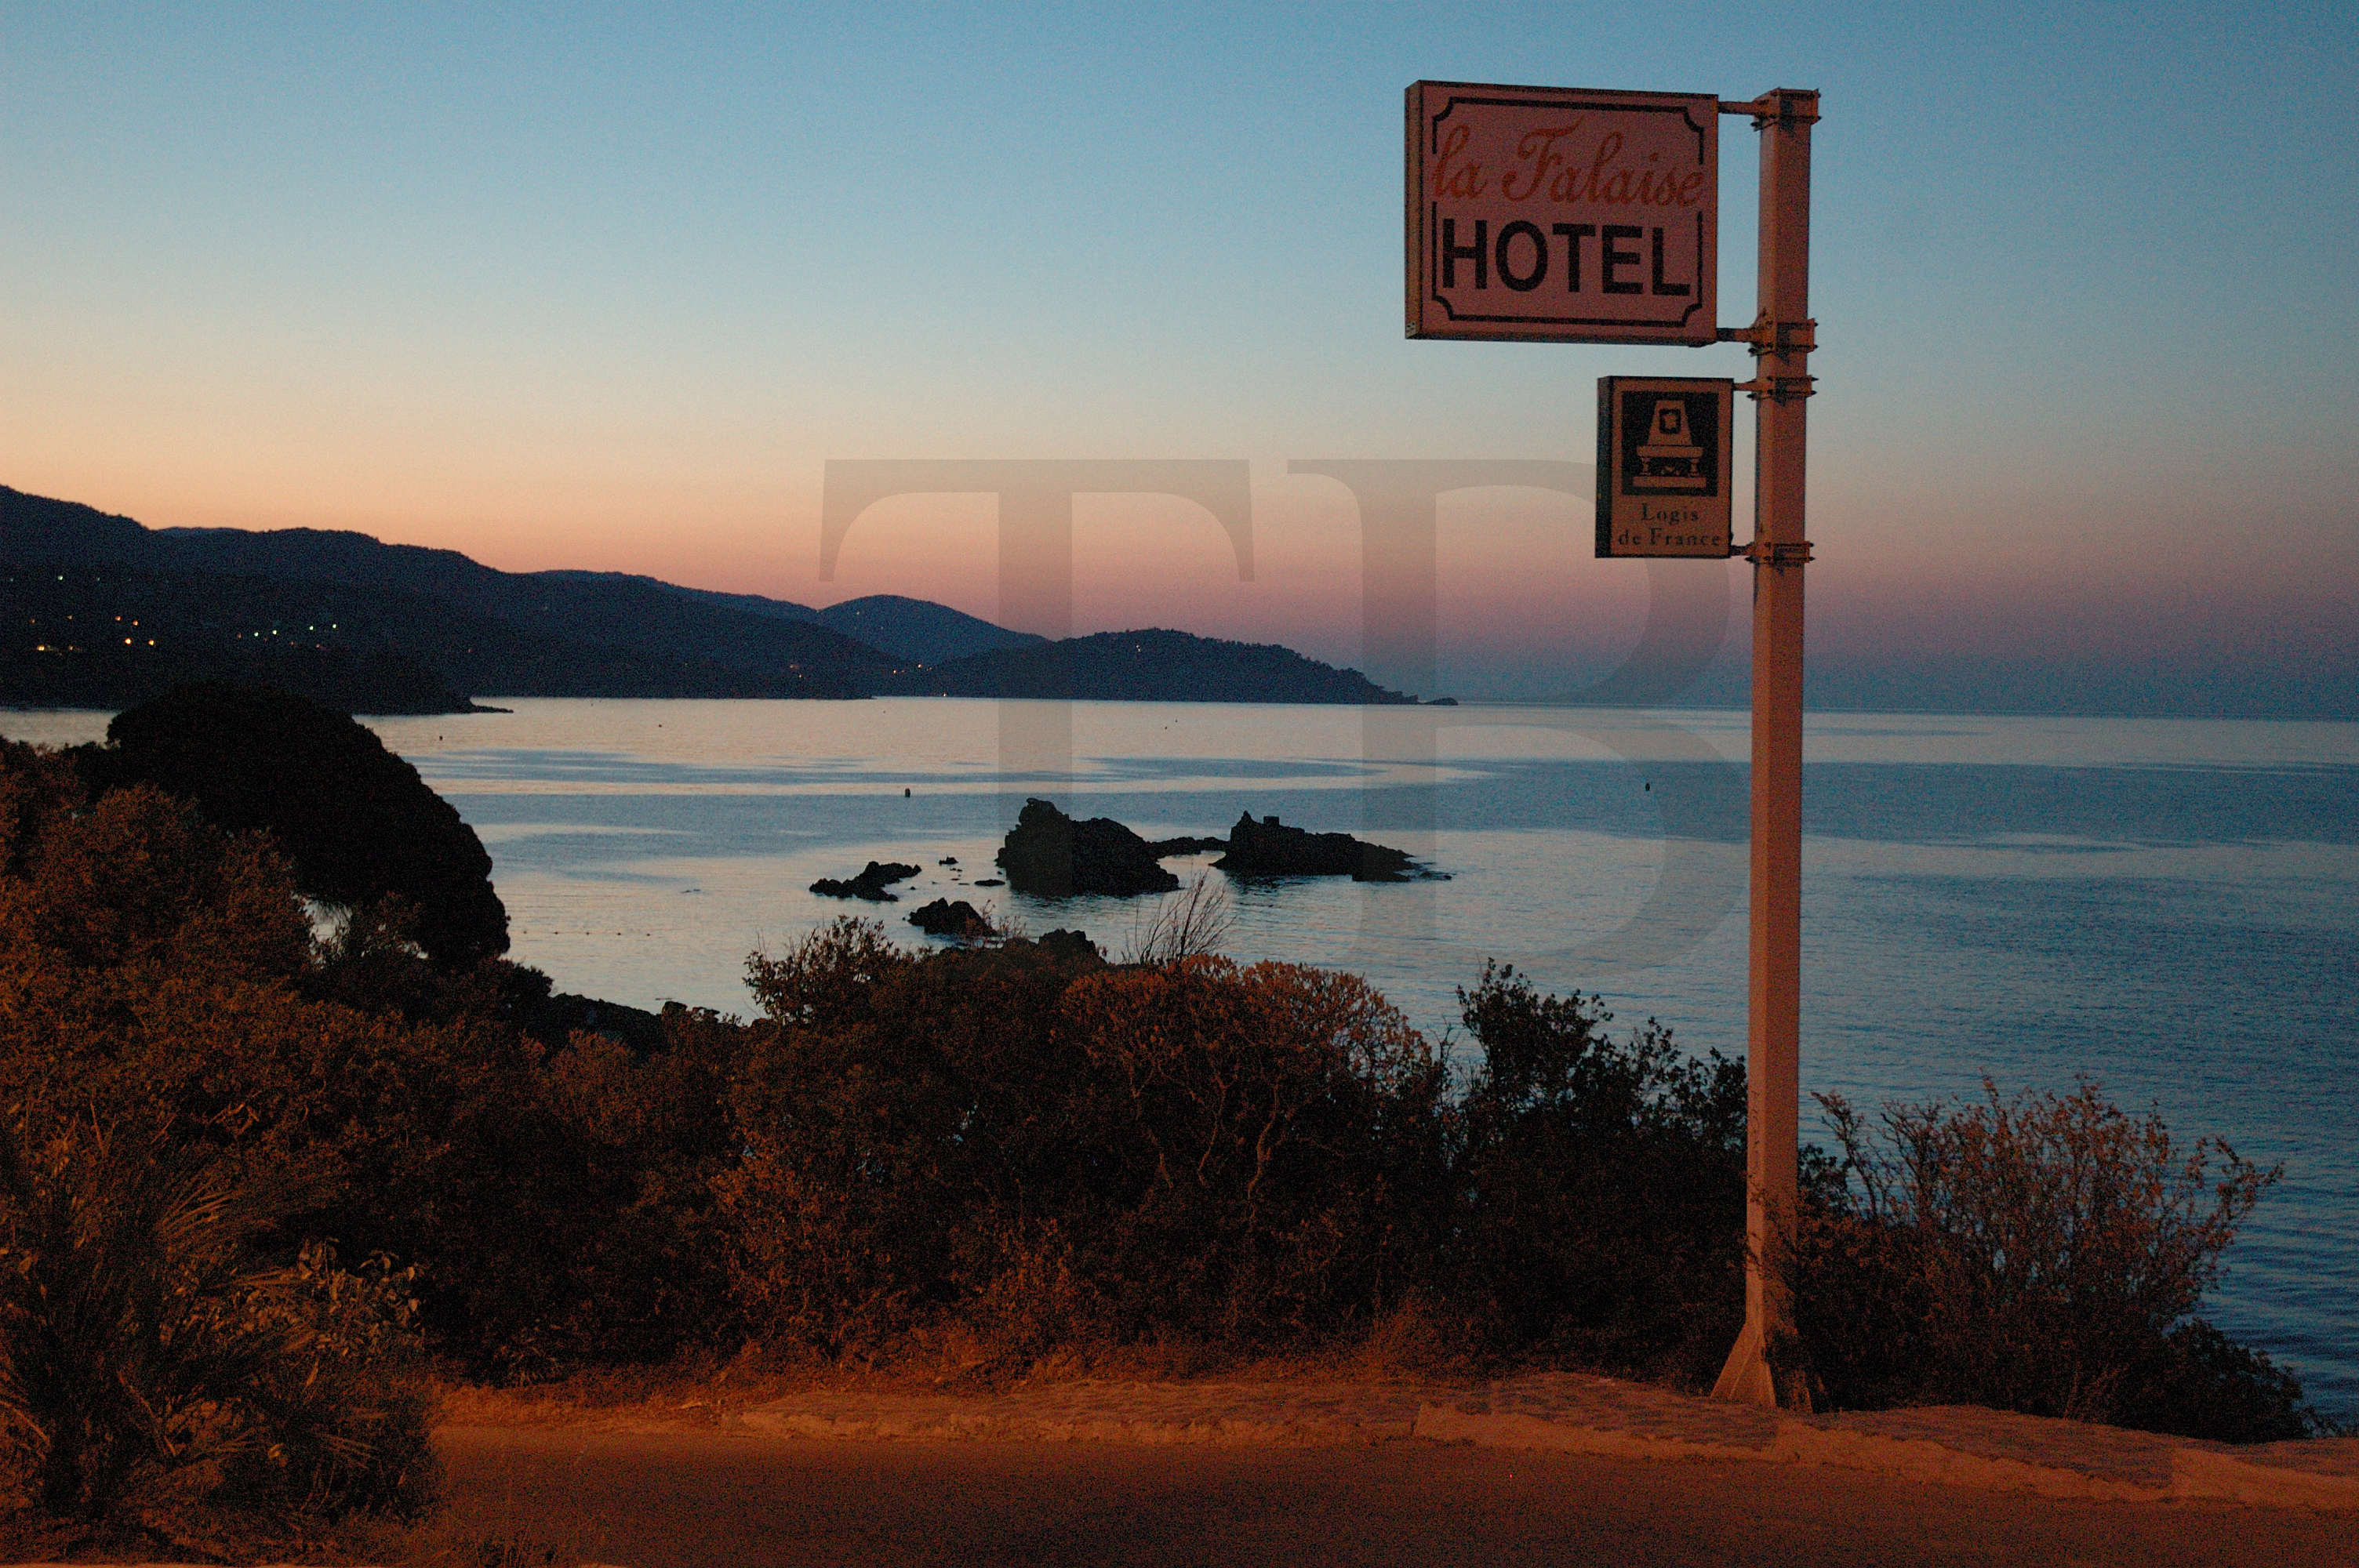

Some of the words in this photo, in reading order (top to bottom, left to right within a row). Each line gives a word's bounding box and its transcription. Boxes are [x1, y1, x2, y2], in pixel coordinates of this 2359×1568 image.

[1501, 114, 1704, 207] Falaise
[1442, 218, 1691, 297] HOTEL
[1617, 530, 1643, 546] de
[1649, 527, 1721, 546] France
[1641, 502, 1699, 525] Logis
